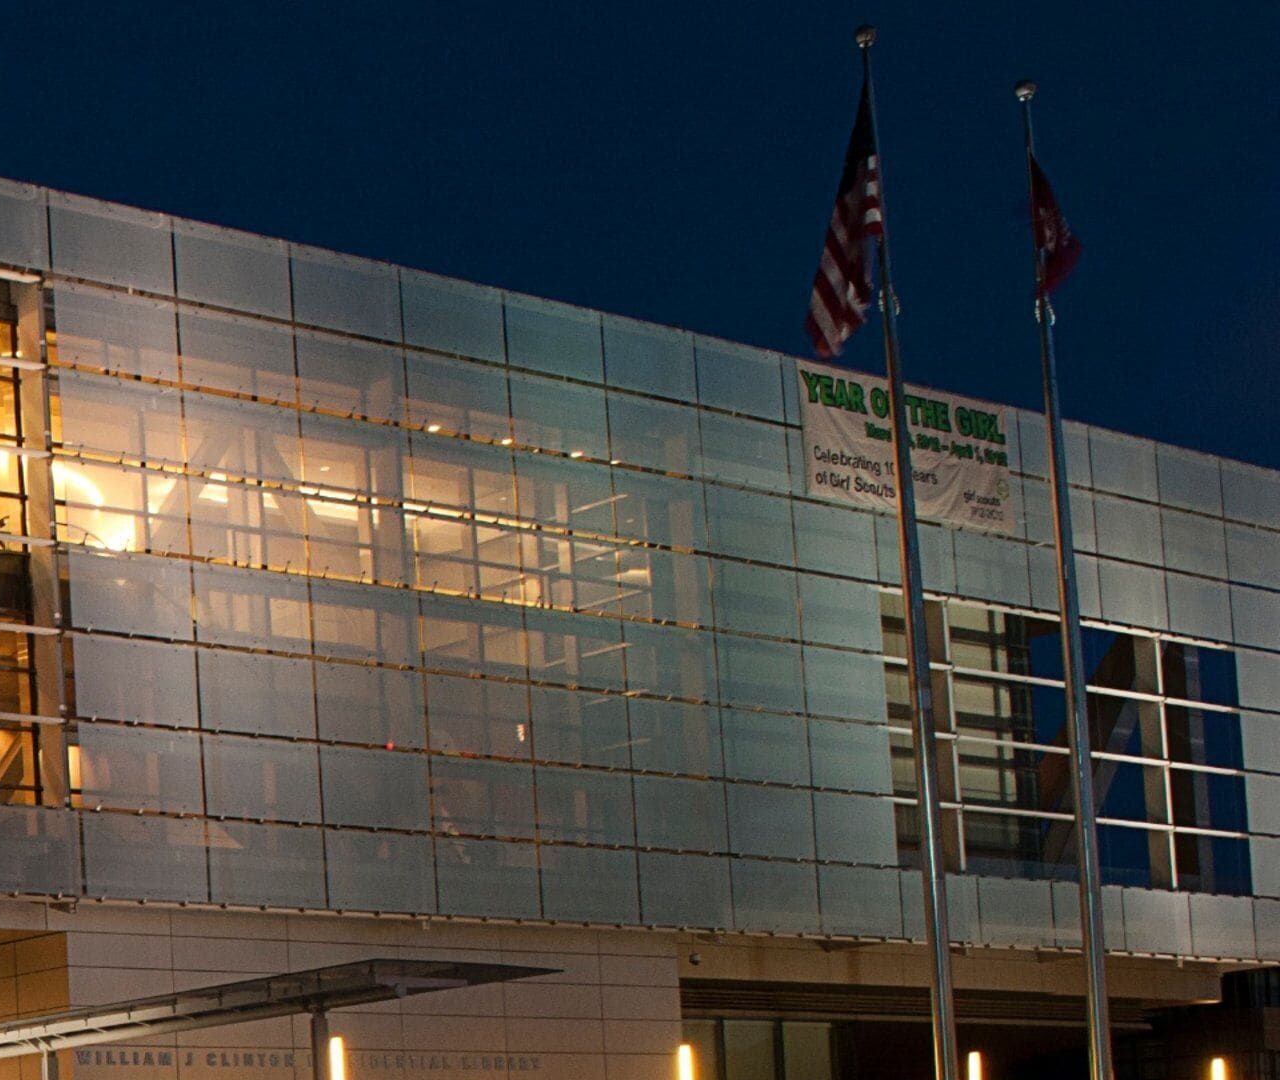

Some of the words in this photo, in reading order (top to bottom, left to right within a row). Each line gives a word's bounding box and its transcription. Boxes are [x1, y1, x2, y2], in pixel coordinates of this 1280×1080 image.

[801, 371, 868, 415] YEAR
[904, 395, 952, 432] THE
[955, 406, 1006, 445] GIRL
[814, 445, 882, 477] Celebrating
[913, 470, 938, 486] ears
[815, 472, 828, 486] of
[829, 473, 851, 491] Girl
[854, 476, 896, 499] Scouts
[76, 1050, 173, 1067] WILLIAM
[205, 1051, 296, 1069] CLINTON
